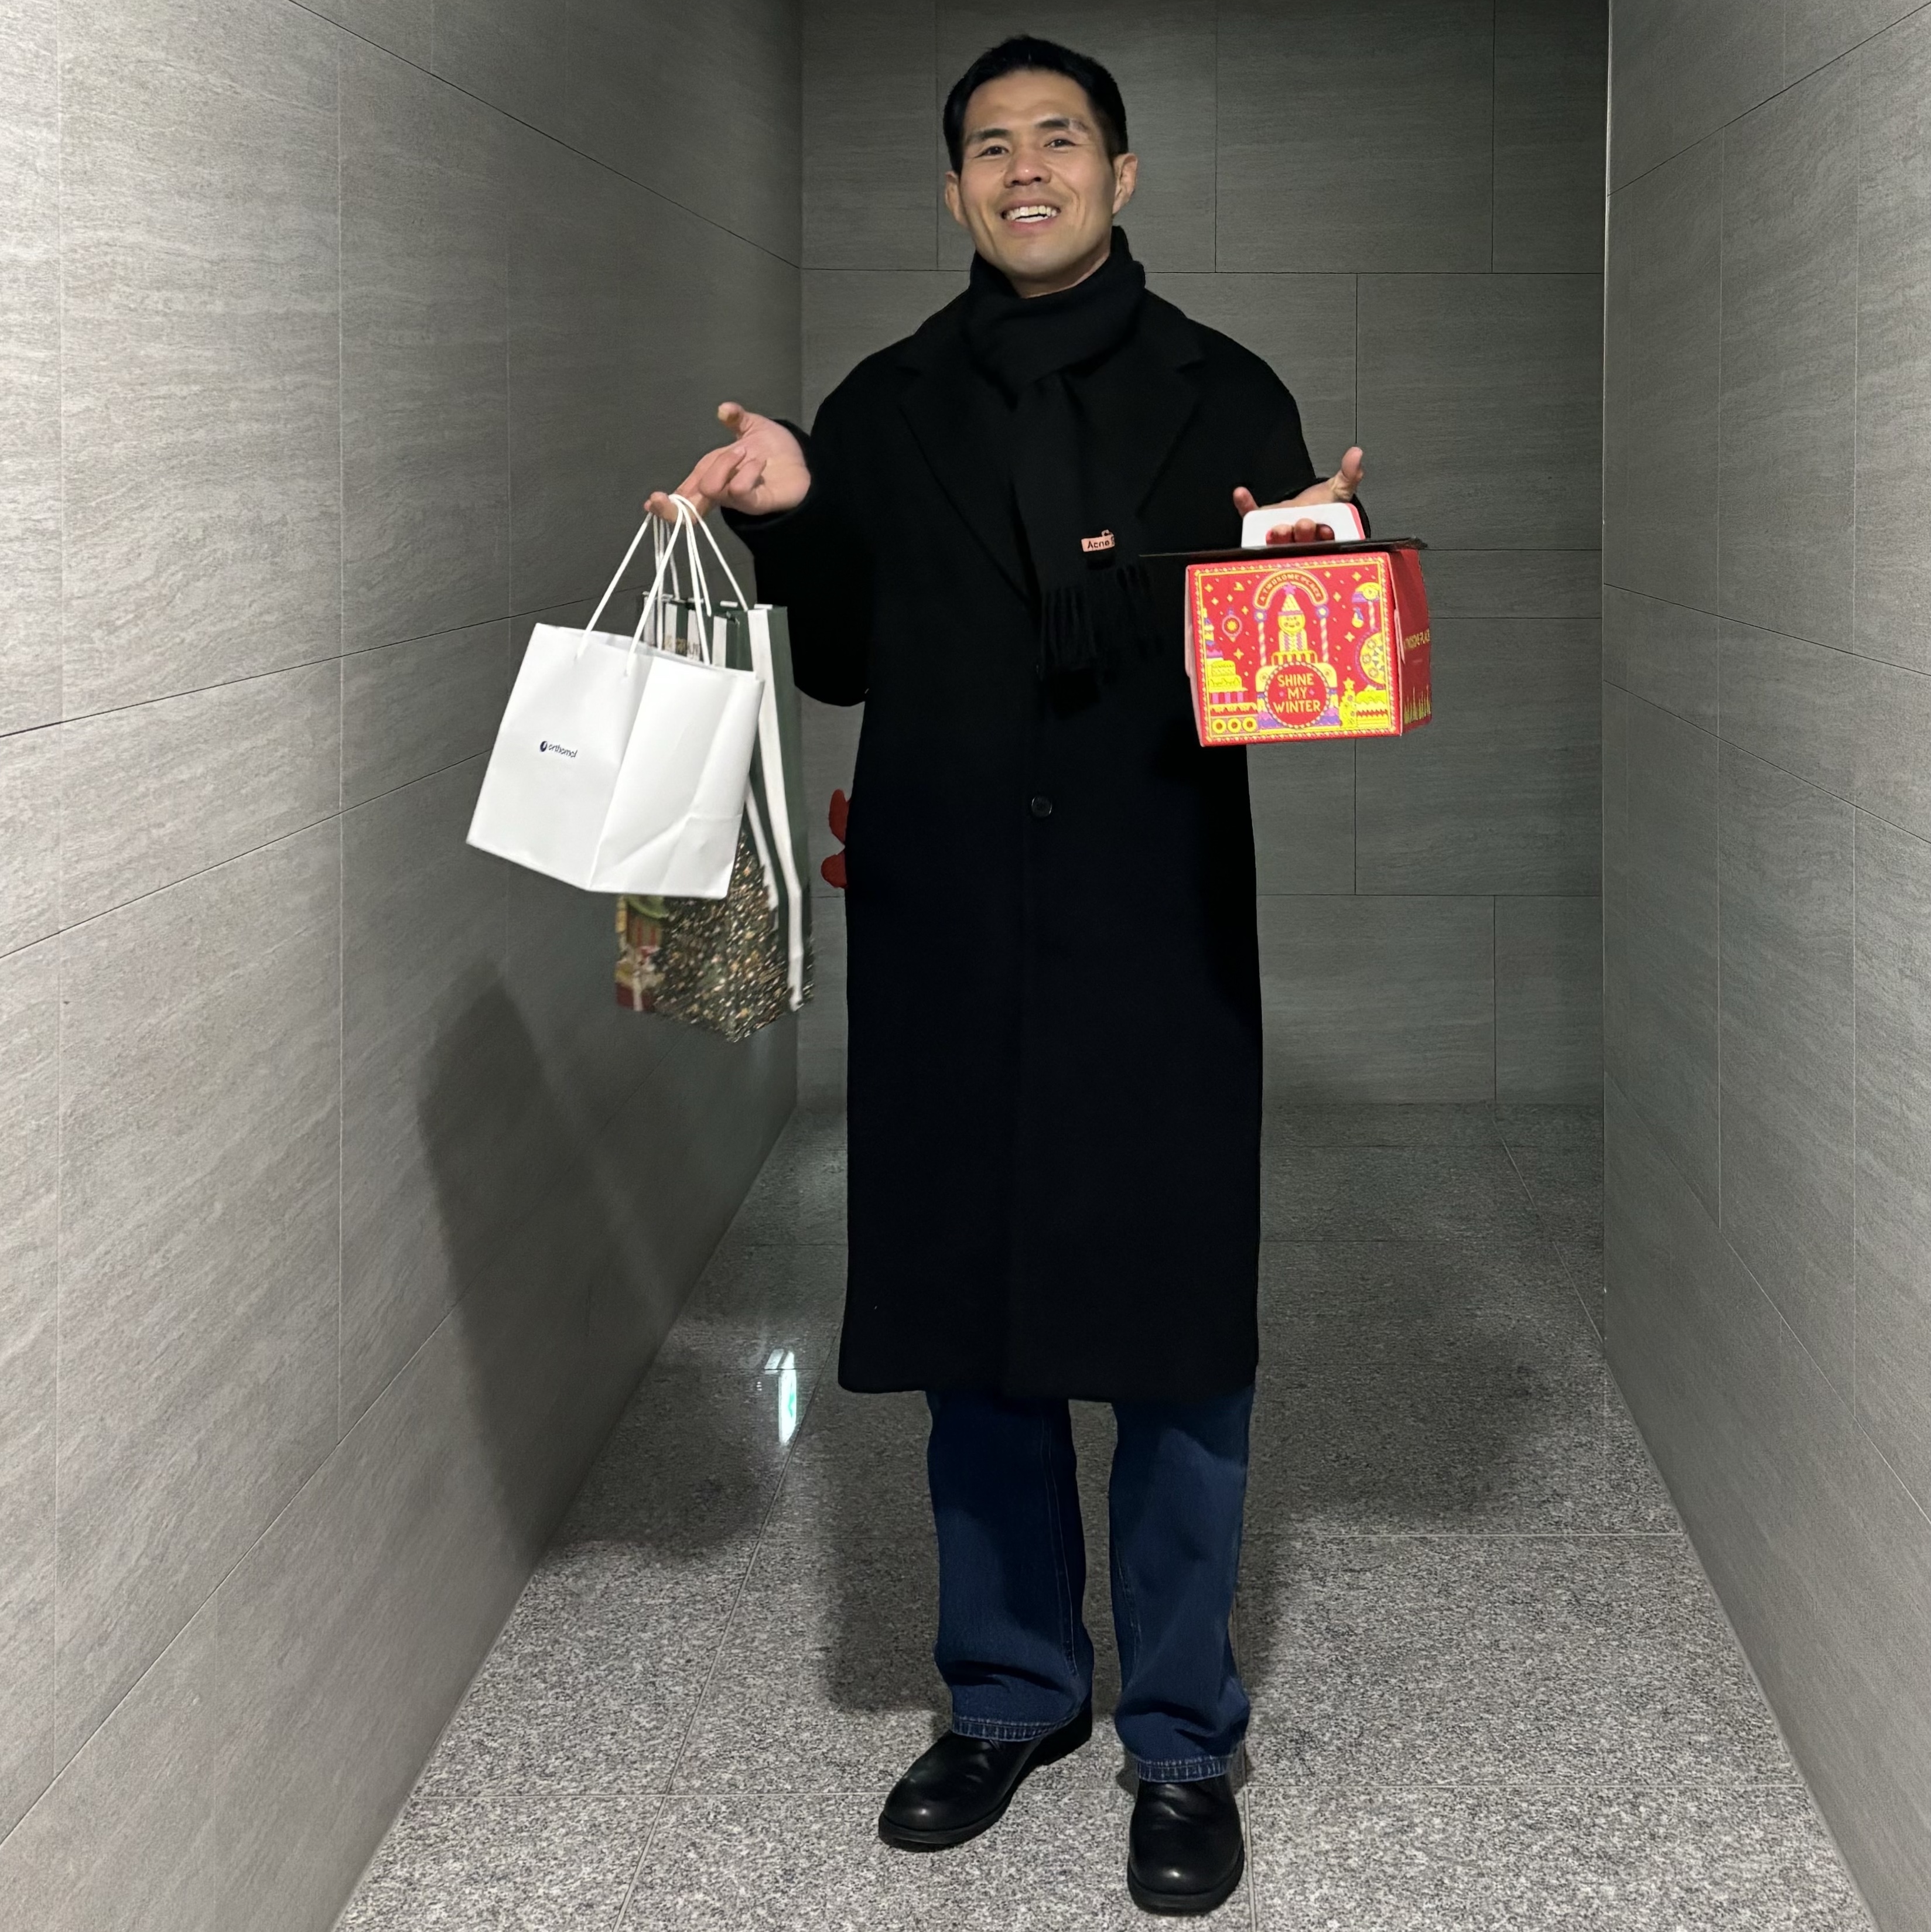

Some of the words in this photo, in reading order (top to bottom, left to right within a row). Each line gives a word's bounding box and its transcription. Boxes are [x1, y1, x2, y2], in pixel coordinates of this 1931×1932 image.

[1088, 540, 1110, 549] Acne
[1277, 673, 1314, 687] SHINE
[1287, 686, 1307, 700] MY
[1272, 699, 1321, 714] WINTER
